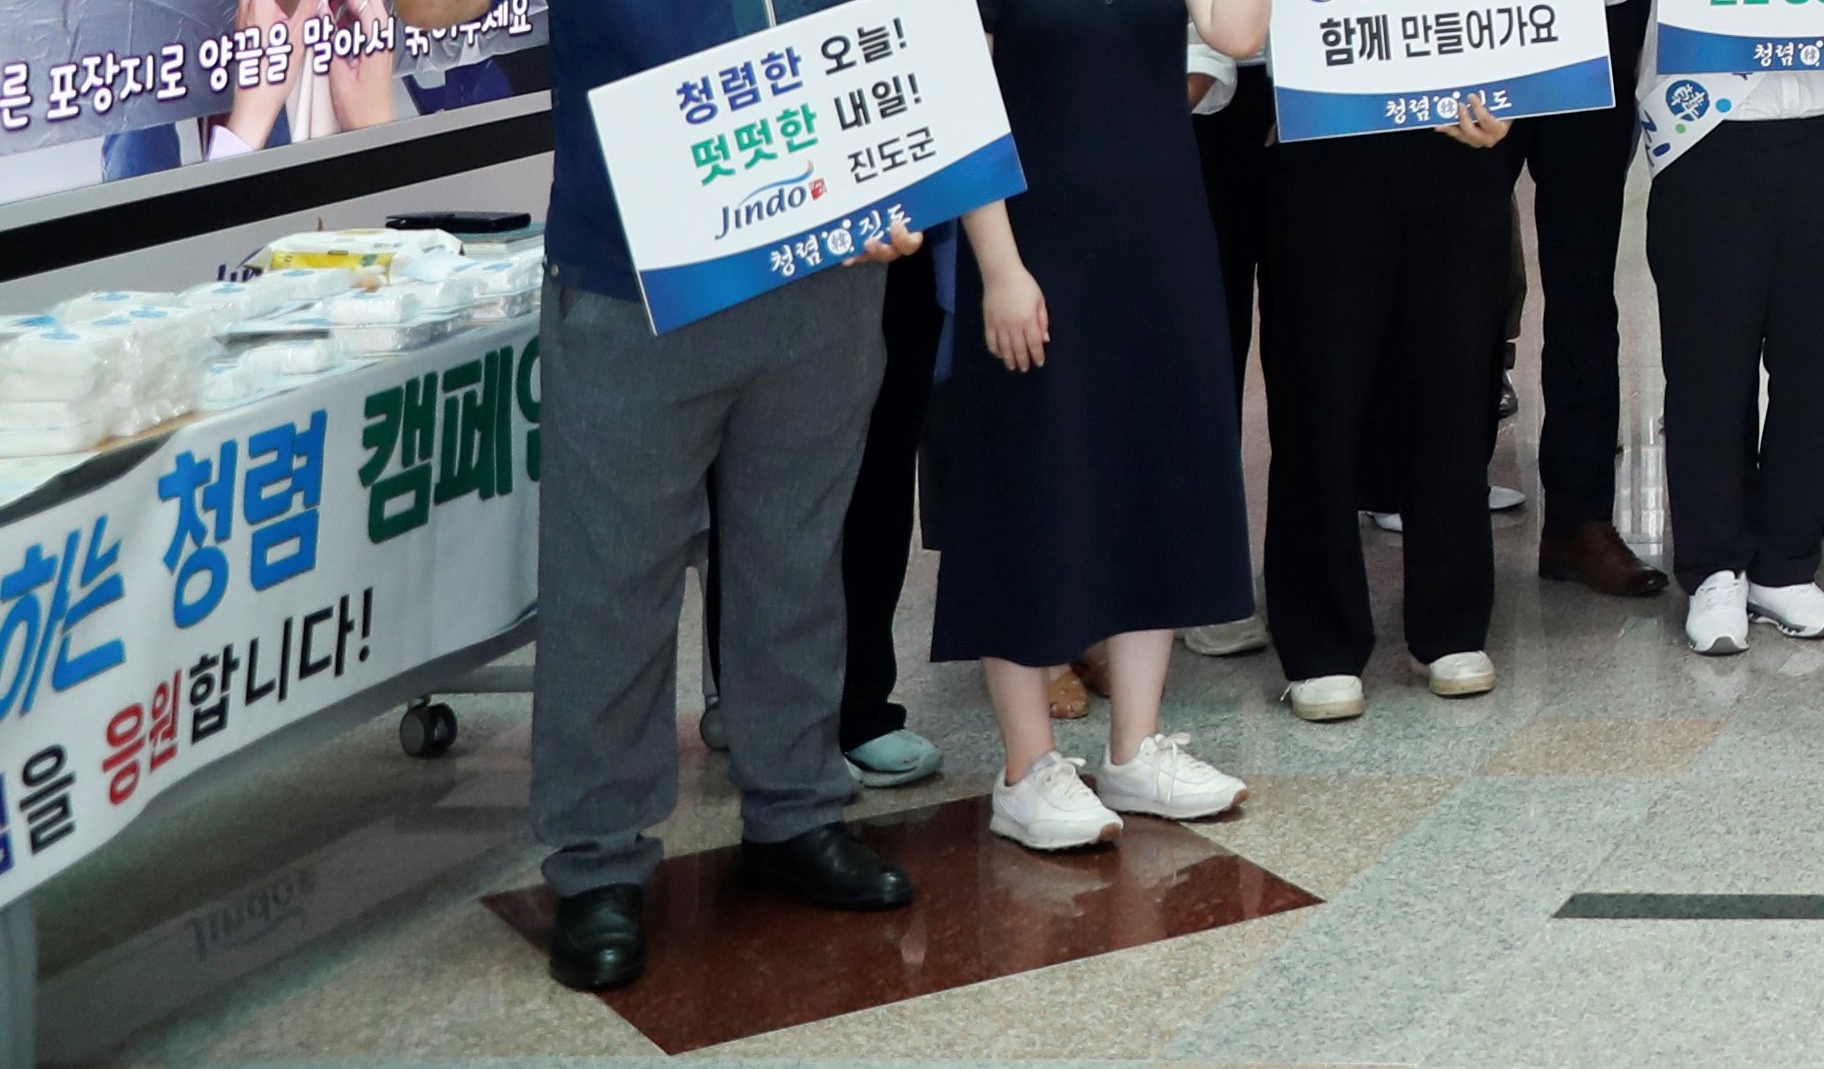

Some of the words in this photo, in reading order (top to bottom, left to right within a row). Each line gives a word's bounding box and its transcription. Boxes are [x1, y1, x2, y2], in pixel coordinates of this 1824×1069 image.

[46, 43, 187, 120] 포장지로
[199, 26, 293, 91] 양끝을
[302, 15, 396, 76] 말아서
[675, 46, 804, 126] 청렴한
[820, 17, 907, 76] 오늘!
[1319, 16, 1392, 67] 함께
[1401, 3, 1559, 59] 만들어가요
[690, 102, 820, 186] 떳떳한
[833, 73, 923, 132] 내일!
[847, 126, 937, 184] 진도군
[714, 184, 808, 240] Jindo
[158, 408, 328, 629] 청렴
[101, 586, 375, 805] 응원합니다!
